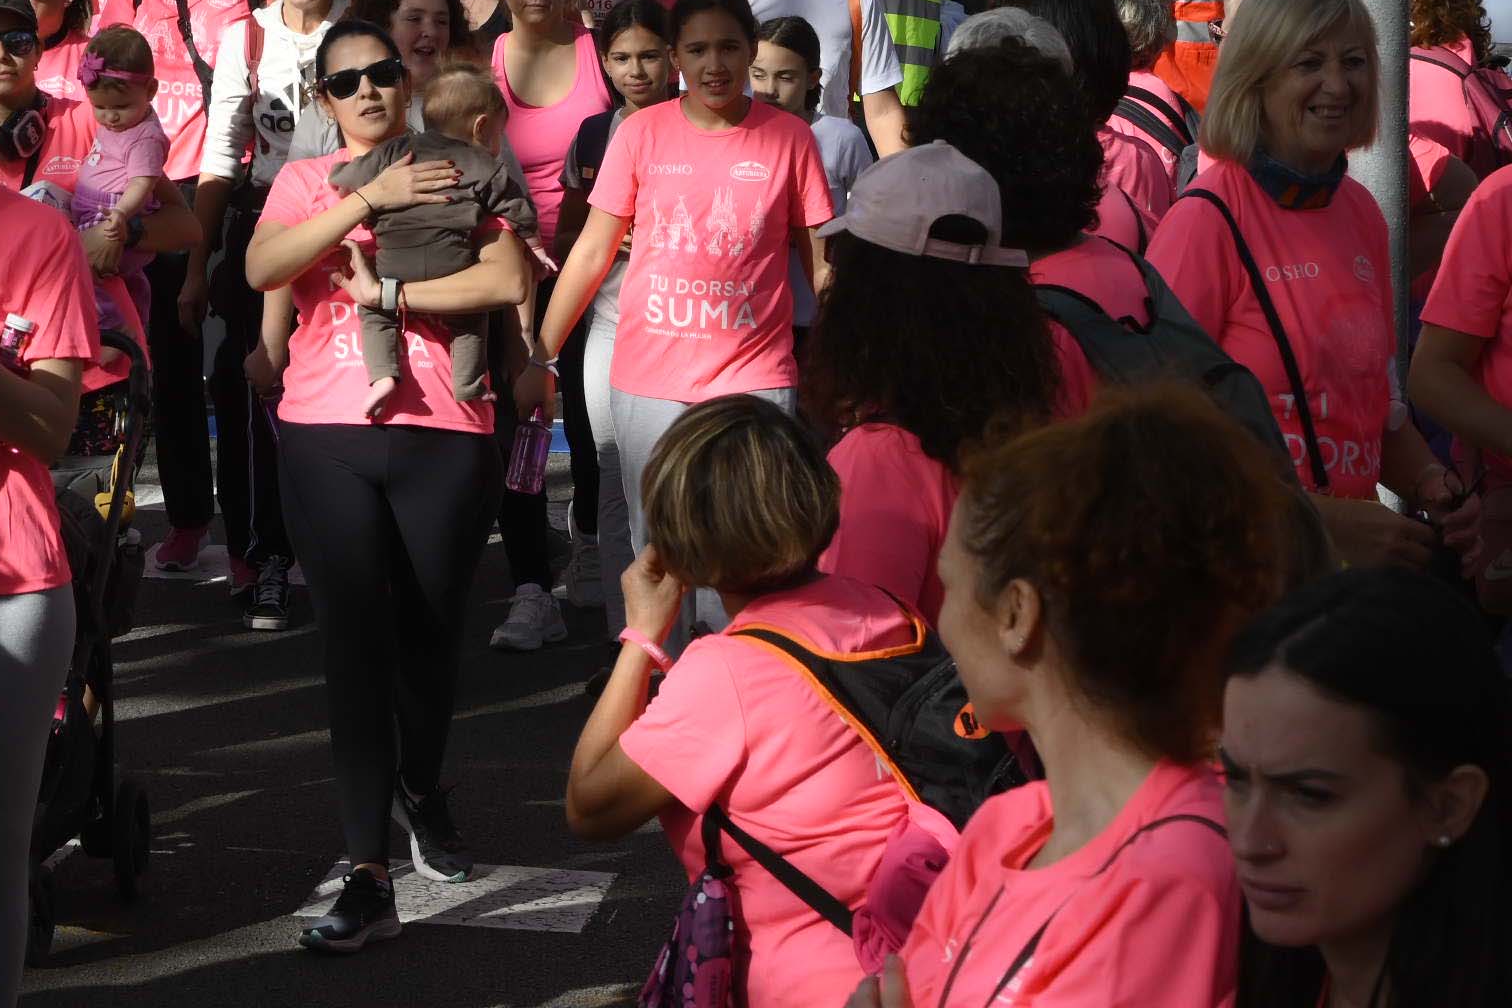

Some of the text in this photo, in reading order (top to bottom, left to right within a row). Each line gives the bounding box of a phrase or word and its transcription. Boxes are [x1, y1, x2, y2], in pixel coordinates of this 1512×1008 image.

[588, 0, 613, 10] 016
[648, 164, 693, 176] OYSHO
[649, 273, 669, 292] TU
[644, 293, 758, 330] SUMA
